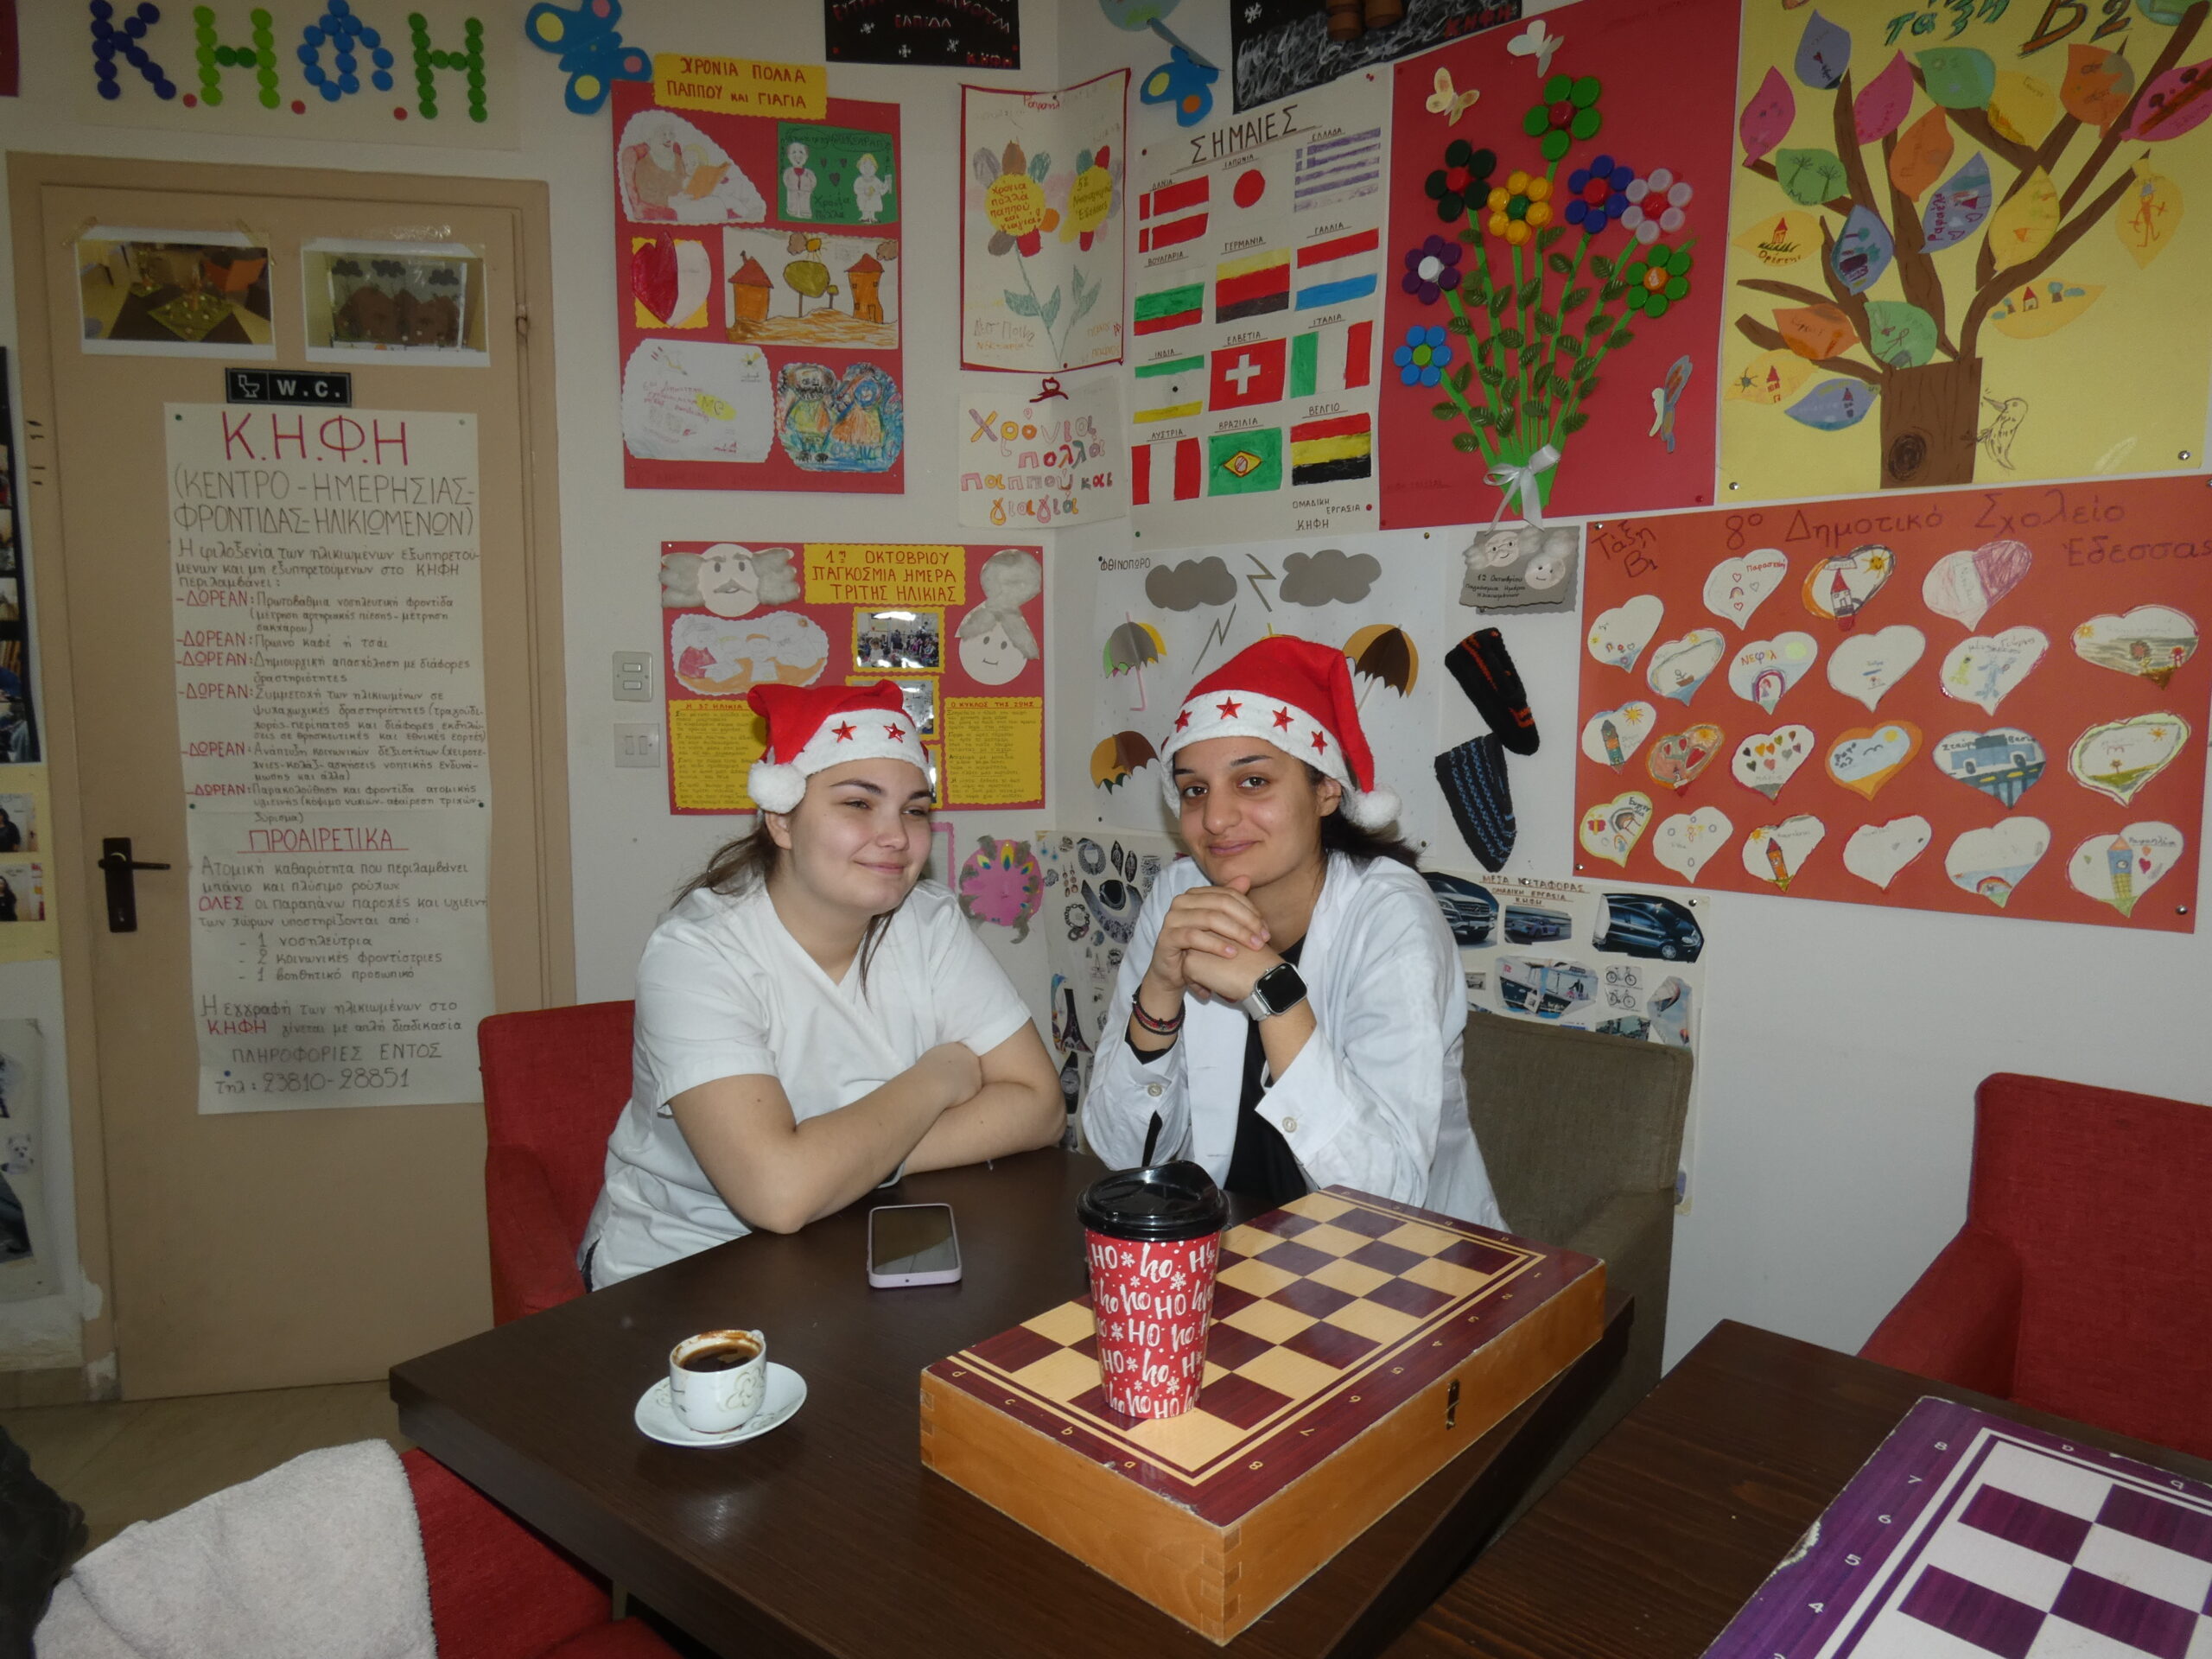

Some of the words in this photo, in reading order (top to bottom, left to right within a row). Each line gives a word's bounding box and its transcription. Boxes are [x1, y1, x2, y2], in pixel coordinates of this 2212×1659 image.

[681, 57, 739, 77] ΧΡΟΝΙΑ
[753, 65, 806, 84] ΠΟΛΛΑ
[667, 80, 722, 99] ΠΑΠΠΟΥ
[759, 92, 806, 109] ΓΙΑΓΙΑ
[1191, 104, 1298, 164] ΣΗΜΑΙΕΣ
[1224, 237, 1264, 251] ΓΕΡΜΑΝΙΑ
[1147, 251, 1184, 265] ΒΟΥΛΓΑΡΙΑ
[1227, 331, 1261, 345] ΕΛΒΕΤΙΑ
[276, 378, 341, 398] W.C.
[1309, 404, 1340, 415] ΒΕΛΓΙΟ
[1218, 418, 1258, 430] ΒΡΑΖΙΛΙΑ
[222, 411, 408, 466] Κ.Η.Φ.Η
[1151, 429, 1183, 440] ΑΥΣΤΡΙΑ
[1081, 473, 1112, 490] και
[1293, 499, 1330, 509] ΟΜΑΔΙΚΗ
[1326, 505, 1360, 514] ΕΡΓΑΣΙΑ
[1297, 518, 1329, 530] ΚΗΦΗ
[1785, 506, 1943, 548] Δημοτικό
[1974, 488, 2125, 537] Σχολείο
[1592, 518, 1656, 560] Τάξη
[178, 538, 194, 557] Η
[277, 547, 304, 558] των
[865, 550, 949, 564] ΟΚΤΩΒΡΙΟΥ
[1101, 557, 1151, 571] ΦΘΙΝΟΠΩΡΟ
[223, 564, 245, 575] και
[381, 566, 404, 575] στο
[812, 566, 896, 582] ΠΑΓΚΟΣΜΙΑ
[903, 569, 957, 582] ΗΜΕΡΑ
[830, 584, 887, 600] ΤΡΙΤΗΣ
[897, 586, 956, 601] ΗΛΙΚΙΑΣ
[249, 827, 392, 851] ΠΡΟΑΙΡΕΤΙΚΑ
[202, 855, 264, 880] Ατομική
[361, 864, 382, 874] που
[264, 882, 284, 893] και
[200, 895, 244, 912] ΟΛΕΣ
[417, 897, 439, 907] και
[200, 995, 217, 1016] Η
[224, 1000, 291, 1019] εγγραφή
[300, 1004, 327, 1015] των
[429, 1001, 458, 1012] στο
[392, 1018, 462, 1033] διαδικασία
[232, 1045, 363, 1064] ΠΛΗΡΟΦΟΡΙΕΣ
[380, 1042, 442, 1060] ΕΝΤΟΣ
[1091, 1243, 1117, 1270] HO
[1140, 1243, 1173, 1283] ho
[1100, 1278, 1119, 1313] ho
[1120, 1284, 1152, 1315] ho
[1154, 1294, 1186, 1319] HO
[1128, 1318, 1160, 1347] HO
[1171, 1323, 1195, 1352] ho
[1103, 1348, 1123, 1374] HO
[1142, 1349, 1170, 1388] ho
[1126, 1388, 1152, 1417] ho
[1154, 1397, 1179, 1419] HO
[1934, 1441, 1948, 1451] 8
[1249, 1461, 1263, 1470] 8
[1907, 1475, 1923, 1484] 7
[1878, 1514, 1892, 1525] 6
[1845, 1554, 1861, 1567] 5
[1808, 1601, 1824, 1615] 4
